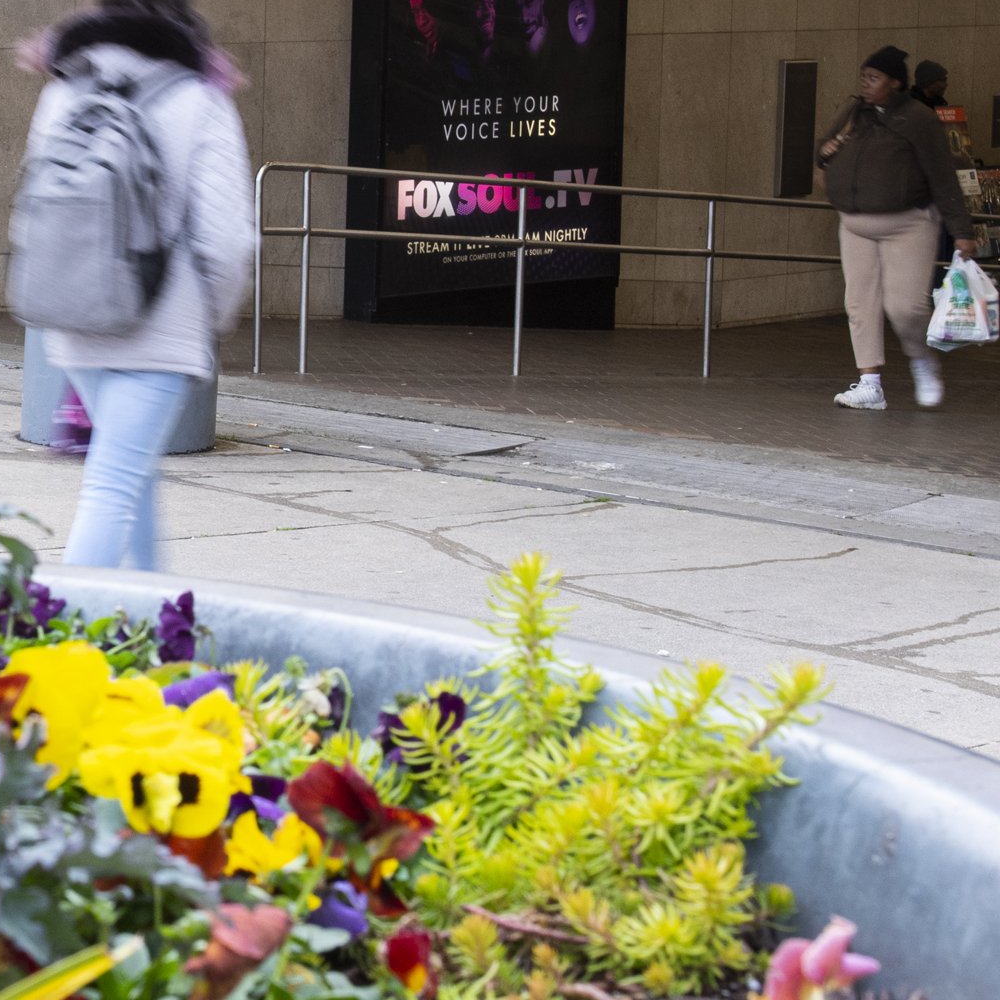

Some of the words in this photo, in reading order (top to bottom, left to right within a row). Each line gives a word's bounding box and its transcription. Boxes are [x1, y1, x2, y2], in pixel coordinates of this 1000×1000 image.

[441, 97, 503, 117] WHERE
[513, 95, 559, 114] YOUR
[443, 121, 500, 141] VOICE
[510, 118, 556, 138] LIVES
[406, 241, 450, 255] STREAM
[544, 227, 588, 242] NIGHTLY
[442, 256, 452, 264] ON
[453, 255, 467, 263] YOUR
[469, 252, 497, 261] COMPUTER
[498, 251, 506, 259] OR
[507, 250, 516, 258] THE
[529, 248, 543, 256] SOUL
